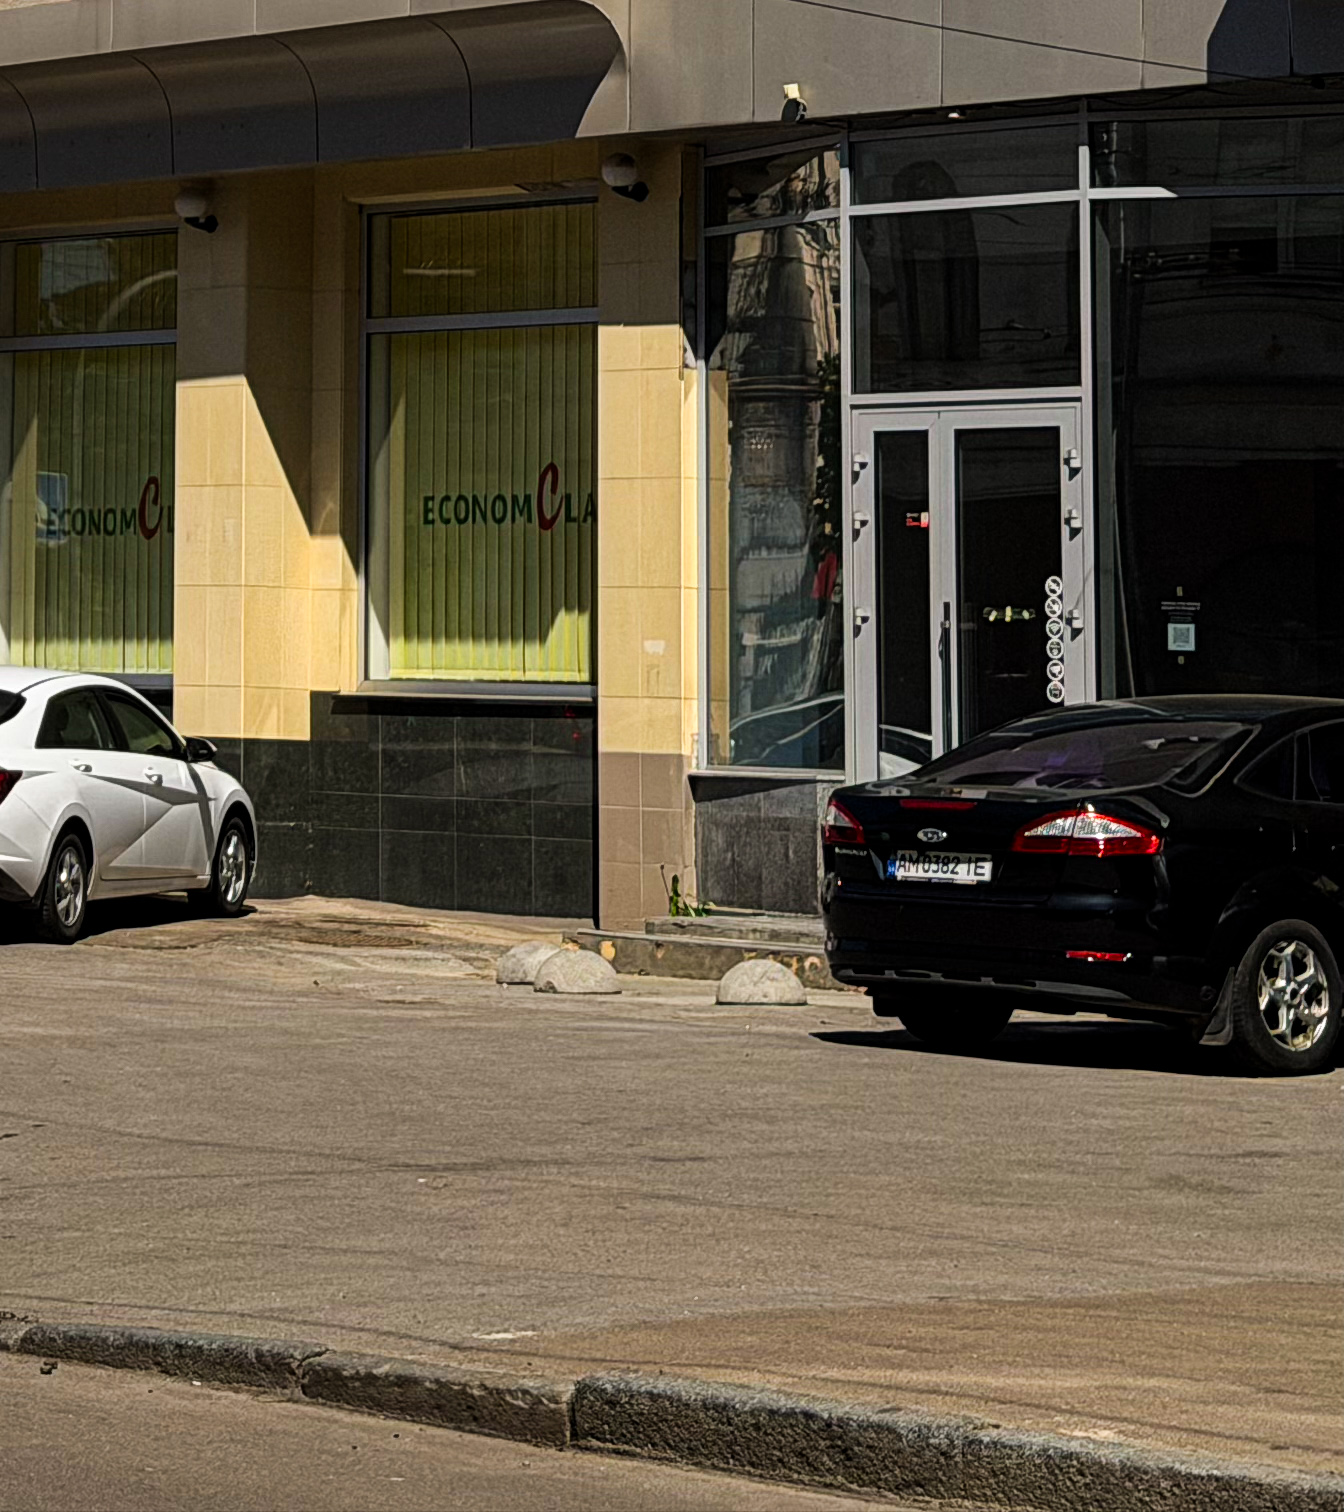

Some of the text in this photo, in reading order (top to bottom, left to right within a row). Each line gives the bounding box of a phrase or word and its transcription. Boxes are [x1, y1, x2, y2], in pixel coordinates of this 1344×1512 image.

[896, 853, 987, 877] AM 0382 IE
